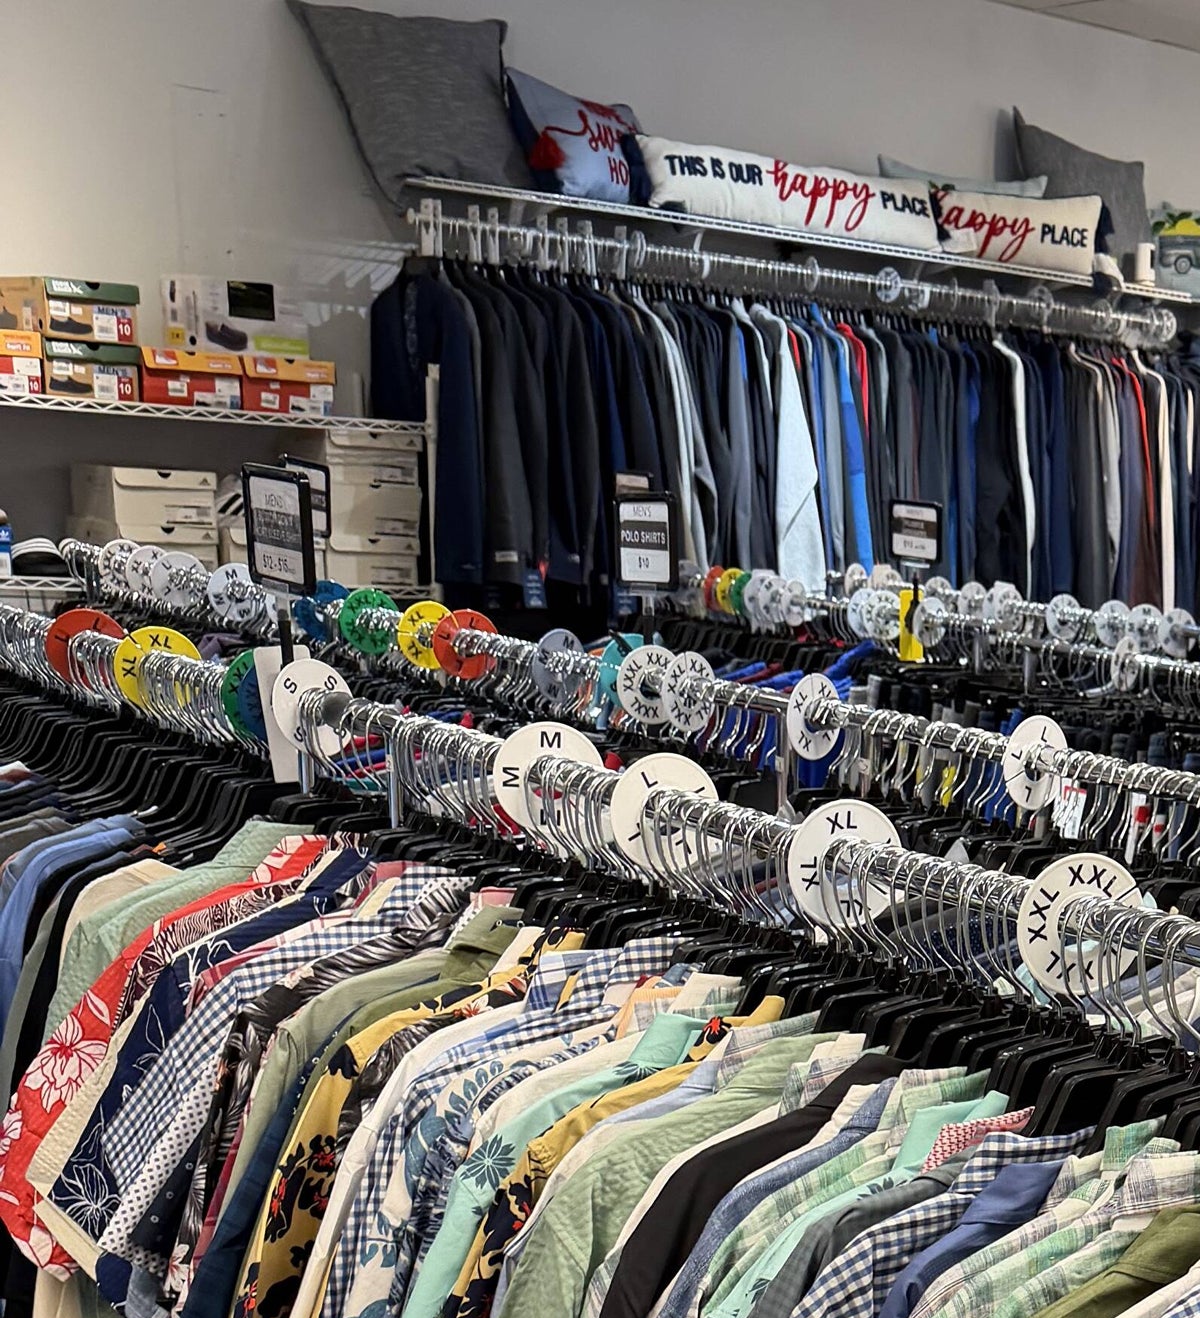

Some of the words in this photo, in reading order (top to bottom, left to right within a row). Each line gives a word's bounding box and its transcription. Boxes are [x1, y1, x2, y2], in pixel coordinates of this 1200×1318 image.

[607, 156, 630, 186] HO
[664, 154, 707, 178] THIS
[711, 157, 726, 180] IS
[729, 163, 764, 187] OUR
[766, 159, 876, 232] happy
[880, 190, 931, 220] PLACE
[1040, 223, 1088, 249] PLACE
[118, 324, 131, 336] 10
[29, 381, 39, 391] 10
[119, 383, 132, 395] 10
[633, 505, 652, 518] MEN'S
[621, 529, 640, 542] POLO
[640, 531, 666, 545] SHIRTS
[638, 556, 650, 569] $10
[225, 568, 238, 581] M
[92, 617, 104, 630] L
[407, 611, 425, 626] XL
[149, 633, 172, 649] XL
[562, 636, 575, 650] M
[122, 656, 137, 678] XL
[646, 652, 671, 670] XXX
[690, 658, 710, 677] XX
[324, 674, 338, 691] S
[623, 660, 643, 692] XXXL
[667, 663, 685, 694] XXL
[283, 677, 298, 694] S
[630, 698, 660, 718] XXXL
[793, 691, 808, 713] XL
[670, 701, 691, 726] XXL
[540, 730, 562, 749] M
[798, 730, 812, 752] XL
[1040, 726, 1048, 743] L
[1011, 749, 1023, 761] L
[502, 766, 520, 788] M
[641, 771, 659, 789] L
[1025, 785, 1032, 803] L
[825, 810, 858, 835] XL
[800, 856, 820, 892] XL
[1068, 863, 1118, 899] XXL
[1027, 886, 1060, 945] XXL
